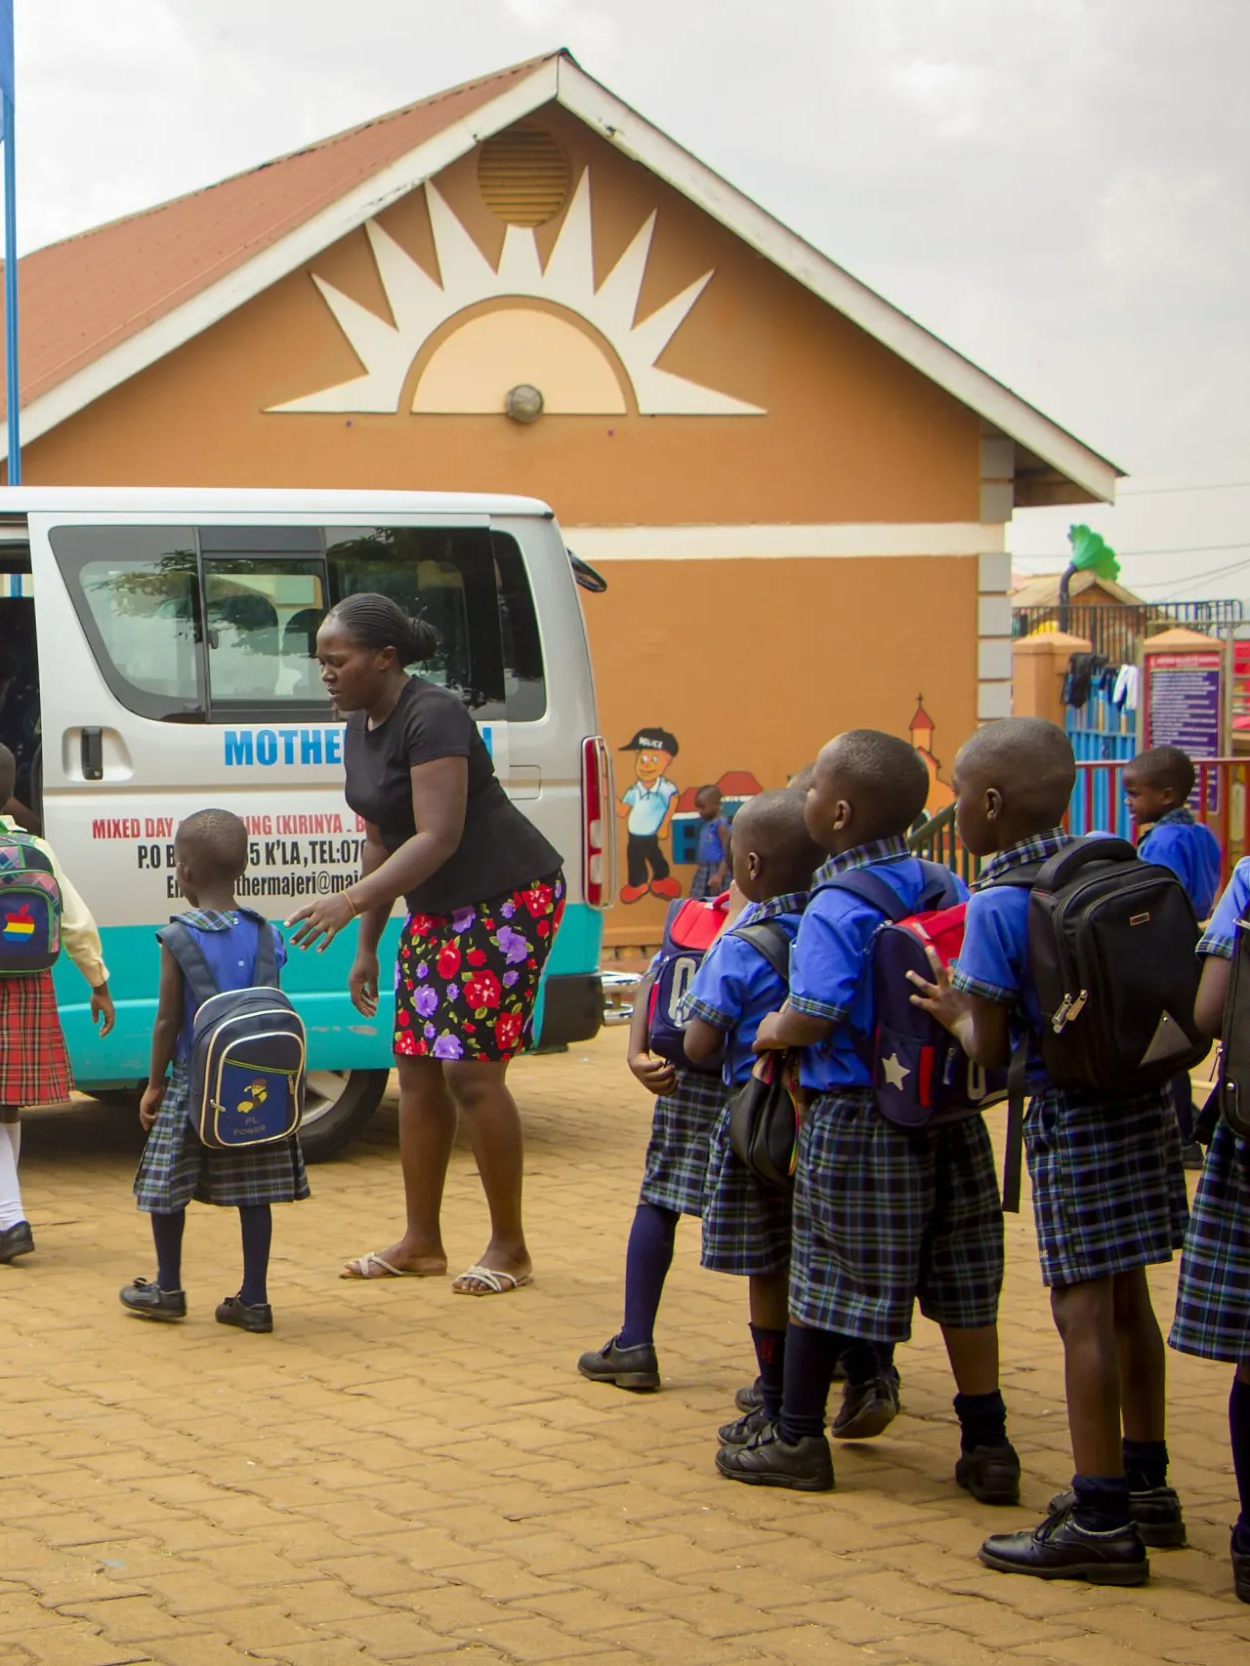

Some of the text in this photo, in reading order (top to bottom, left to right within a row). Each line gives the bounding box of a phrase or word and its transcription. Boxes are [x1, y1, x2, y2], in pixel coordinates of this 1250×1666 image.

[224, 729, 347, 766] MOTHE
[638, 736, 664, 749] POLICE
[92, 818, 141, 839] MIXED
[146, 817, 174, 838] DAY
[137, 844, 161, 869] P.O
